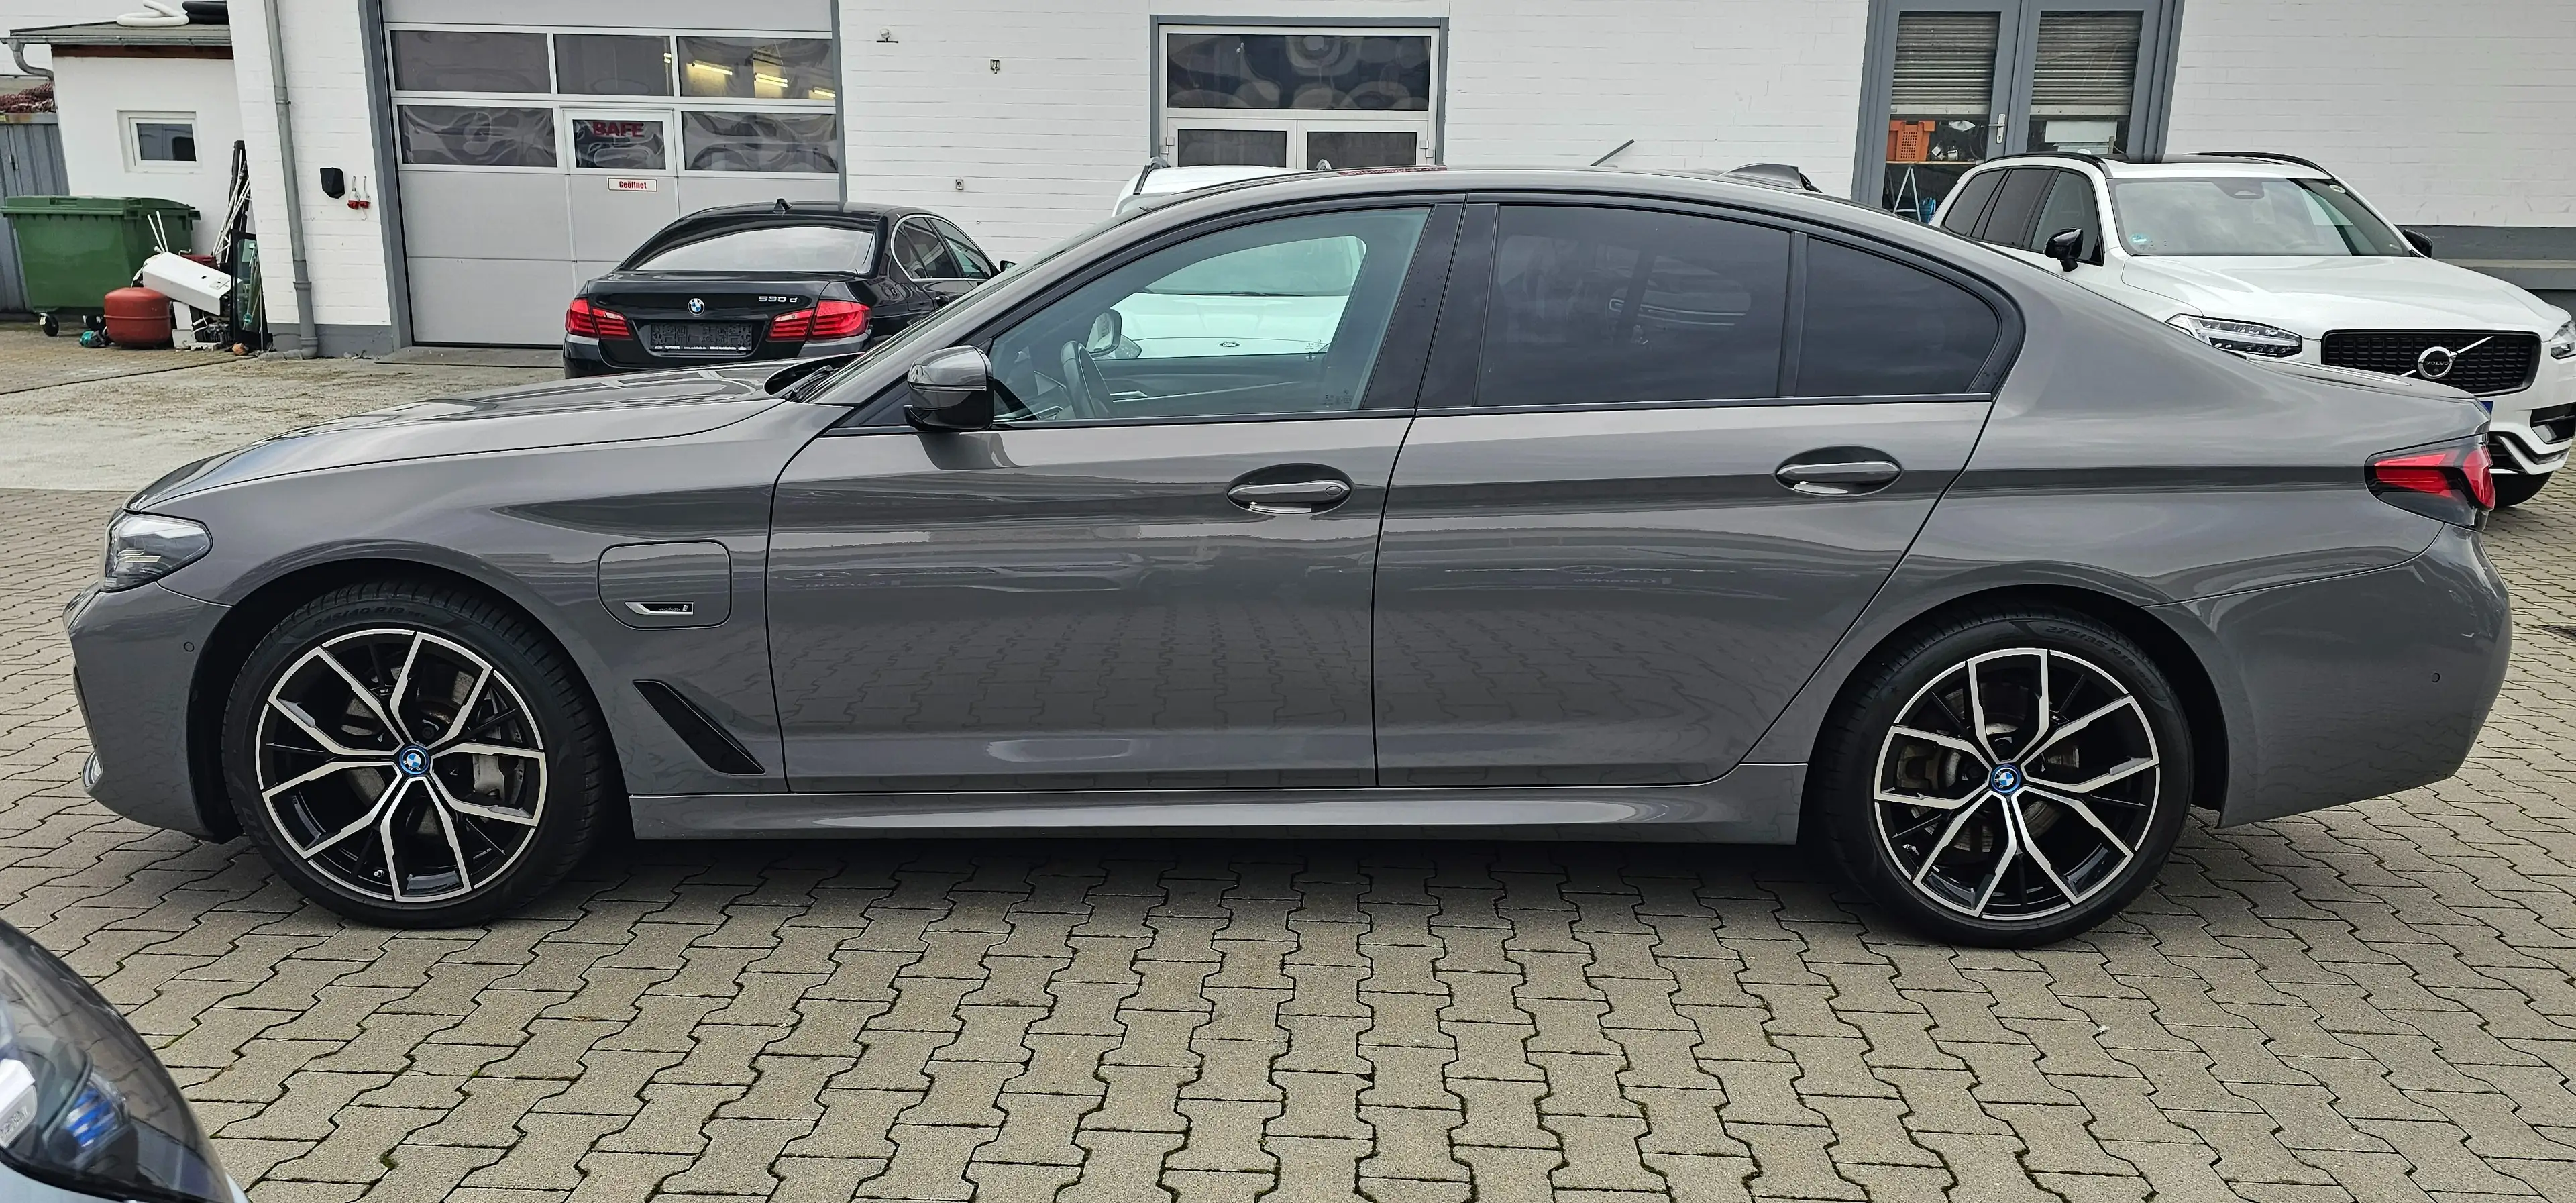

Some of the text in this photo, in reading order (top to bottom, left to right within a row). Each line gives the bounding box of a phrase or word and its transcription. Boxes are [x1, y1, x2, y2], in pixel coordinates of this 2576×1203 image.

[592, 121, 644, 137] BAFE
[619, 180, 647, 189] Geöffnet
[2045, 625, 2108, 649] 275/35
